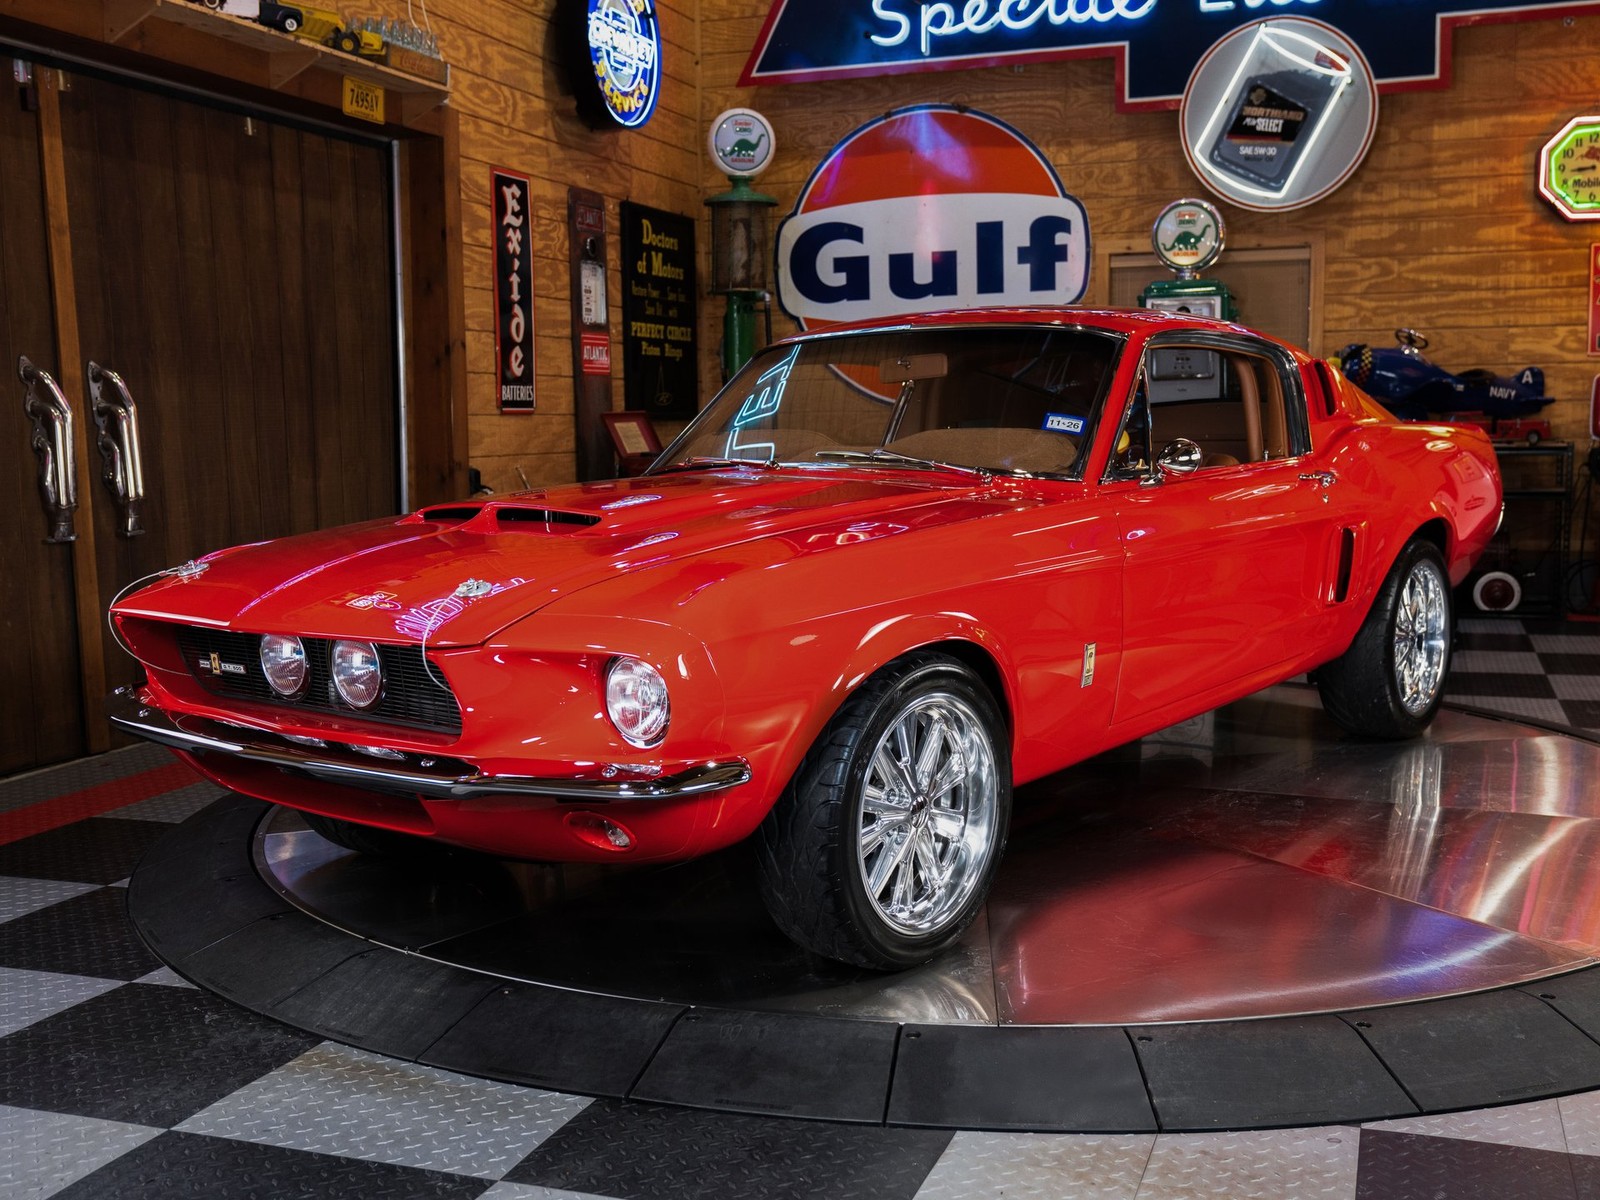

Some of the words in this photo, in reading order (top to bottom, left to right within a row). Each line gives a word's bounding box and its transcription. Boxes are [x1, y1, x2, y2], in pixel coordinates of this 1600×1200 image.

[1256, 117, 1284, 133] SELECT
[1575, 138, 1583, 147] 11
[1589, 133, 1600, 143] 12
[1239, 145, 1253, 156] SAE
[1562, 148, 1574, 158] 10
[1558, 164, 1566, 173] 9
[1572, 176, 1600, 188] Mobil
[1574, 190, 1580, 199] 7
[1588, 192, 1596, 202] 6
[641, 219, 679, 251] Doctors
[637, 252, 647, 274] of
[651, 251, 684, 280] Motors
[789, 215, 1072, 304] Gulf
[502, 183, 525, 377] Exide
[631, 321, 665, 339] PERFECT
[667, 325, 692, 342] CIRCLE
[583, 345, 608, 361] ATLANTIC
[1521, 370, 1533, 384] A
[501, 384, 534, 402] BATTERIES
[1489, 385, 1516, 400] NAVY
